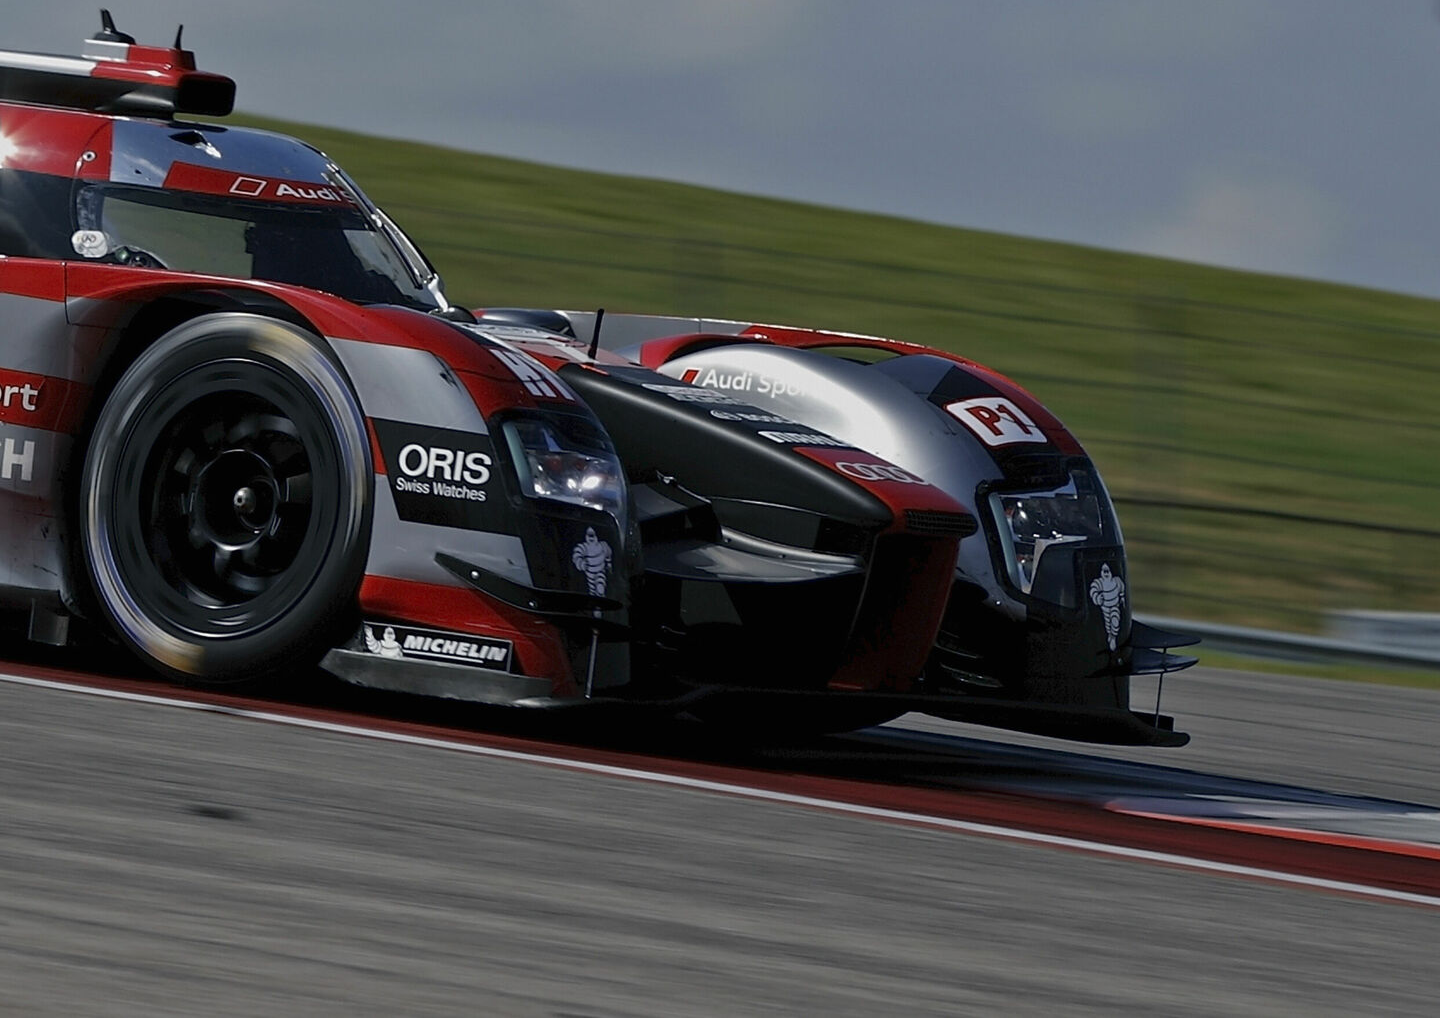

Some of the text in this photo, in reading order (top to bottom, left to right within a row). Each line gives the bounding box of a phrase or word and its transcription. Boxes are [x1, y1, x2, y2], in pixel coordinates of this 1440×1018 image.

[276, 183, 342, 202] Audi
[702, 369, 753, 391] Audi
[757, 375, 813, 398] Spo
[964, 403, 1033, 436] P1
[399, 444, 492, 484] ORIS
[396, 477, 487, 501] Swiss Watches
[403, 634, 507, 661] MICHELIN
